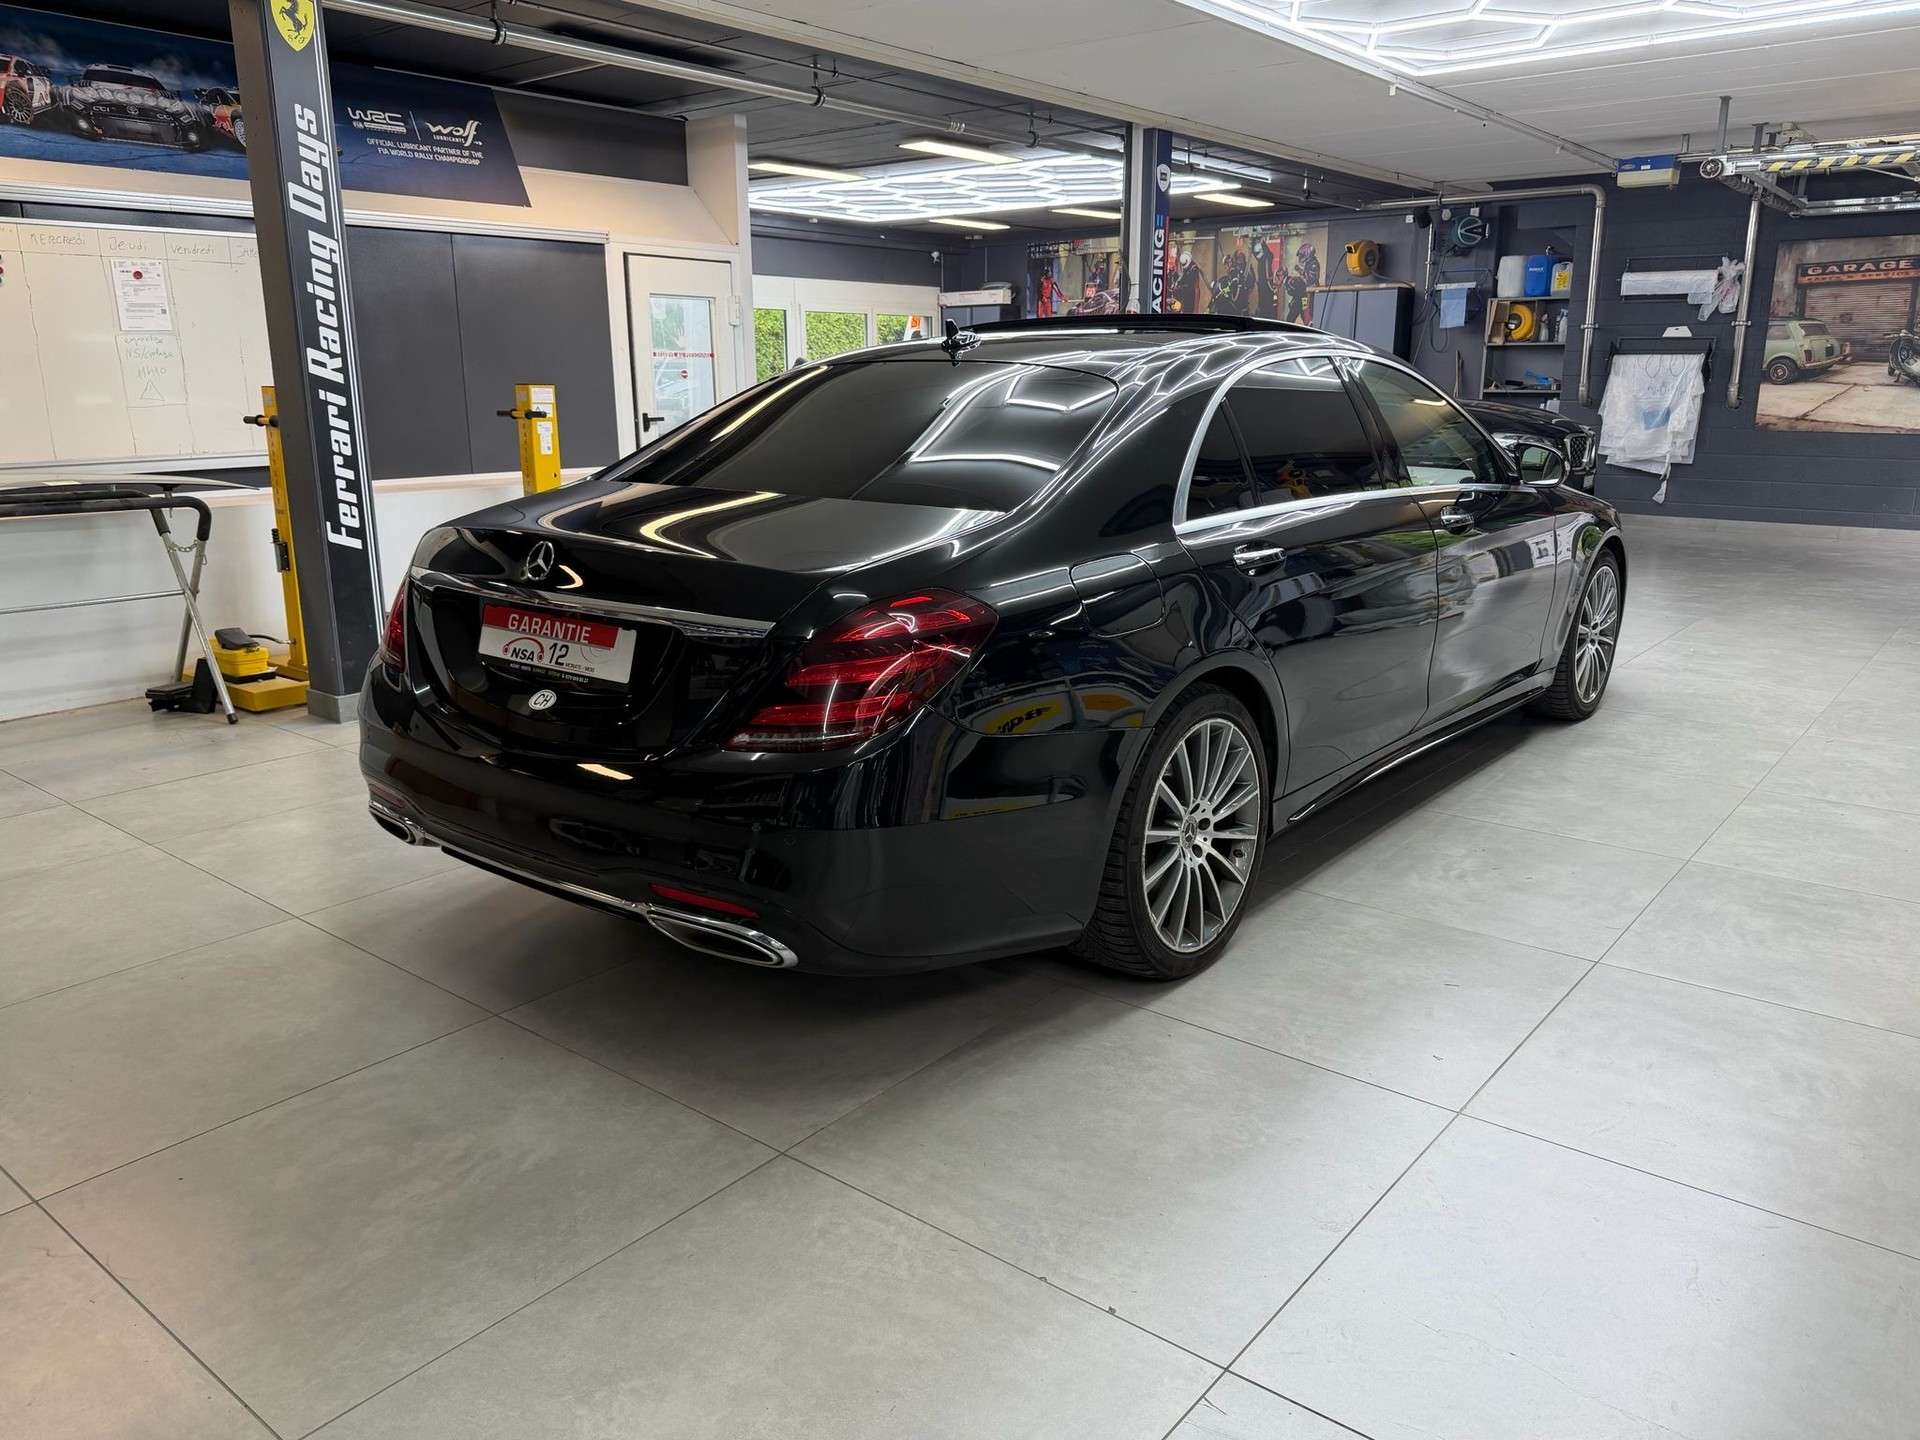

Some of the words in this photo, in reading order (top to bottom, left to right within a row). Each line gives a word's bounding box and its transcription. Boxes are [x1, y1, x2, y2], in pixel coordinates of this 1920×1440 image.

[347, 106, 405, 125] WRC
[366, 137, 396, 149] OFFICIAL
[396, 141, 433, 152] LUBRICANT
[433, 146, 462, 157] PARTNER
[461, 149, 472, 157] OF
[472, 150, 484, 159] THE
[433, 134, 466, 144] LUBRICANTS
[287, 103, 330, 224] Days
[378, 147, 390, 155] FIA
[390, 148, 414, 159] WORLD
[414, 152, 434, 161] RALLY
[434, 154, 481, 166] CHAMPIONSHIP
[1807, 260, 1915, 275] GARAGE
[306, 229, 345, 385] Racing
[318, 388, 363, 550] Ferrari
[507, 613, 592, 644] GARANTIE
[510, 647, 536, 662] NSA
[548, 642, 570, 667] 12
[533, 693, 553, 707] CH
